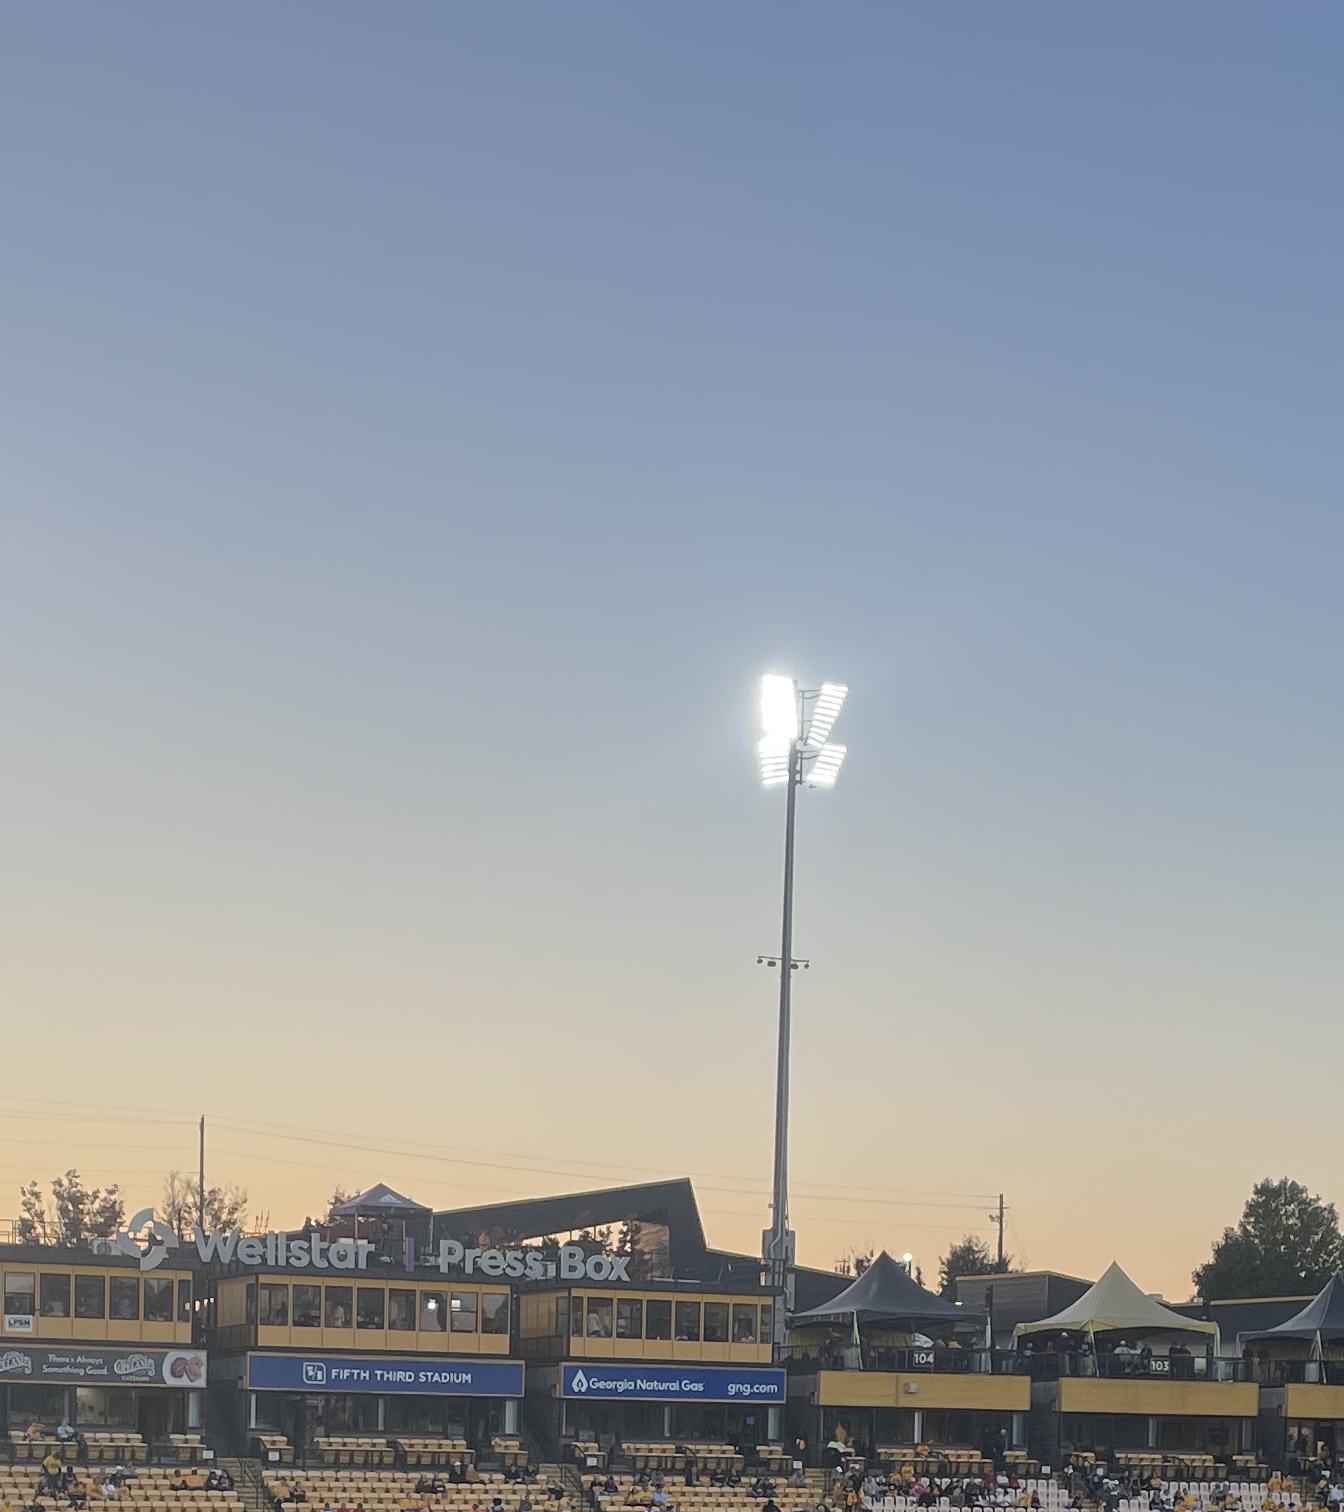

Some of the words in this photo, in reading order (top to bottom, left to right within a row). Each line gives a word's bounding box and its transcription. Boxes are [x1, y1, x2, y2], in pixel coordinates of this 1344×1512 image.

[192, 1226, 376, 1270] Wellstar
[439, 1239, 544, 1278] Press
[560, 1244, 631, 1282] Box
[76, 1355, 104, 1364] Always
[914, 1353, 934, 1363] 104
[42, 1365, 85, 1376] Something
[1150, 1361, 1170, 1371] 103
[331, 1368, 370, 1381] FIFTH
[374, 1370, 415, 1382] THIRD
[419, 1371, 472, 1384] STADIUM
[589, 1378, 635, 1393] Georgia
[637, 1379, 680, 1391] Natural
[681, 1380, 704, 1392] Gas
[728, 1383, 778, 1395] gng.com
